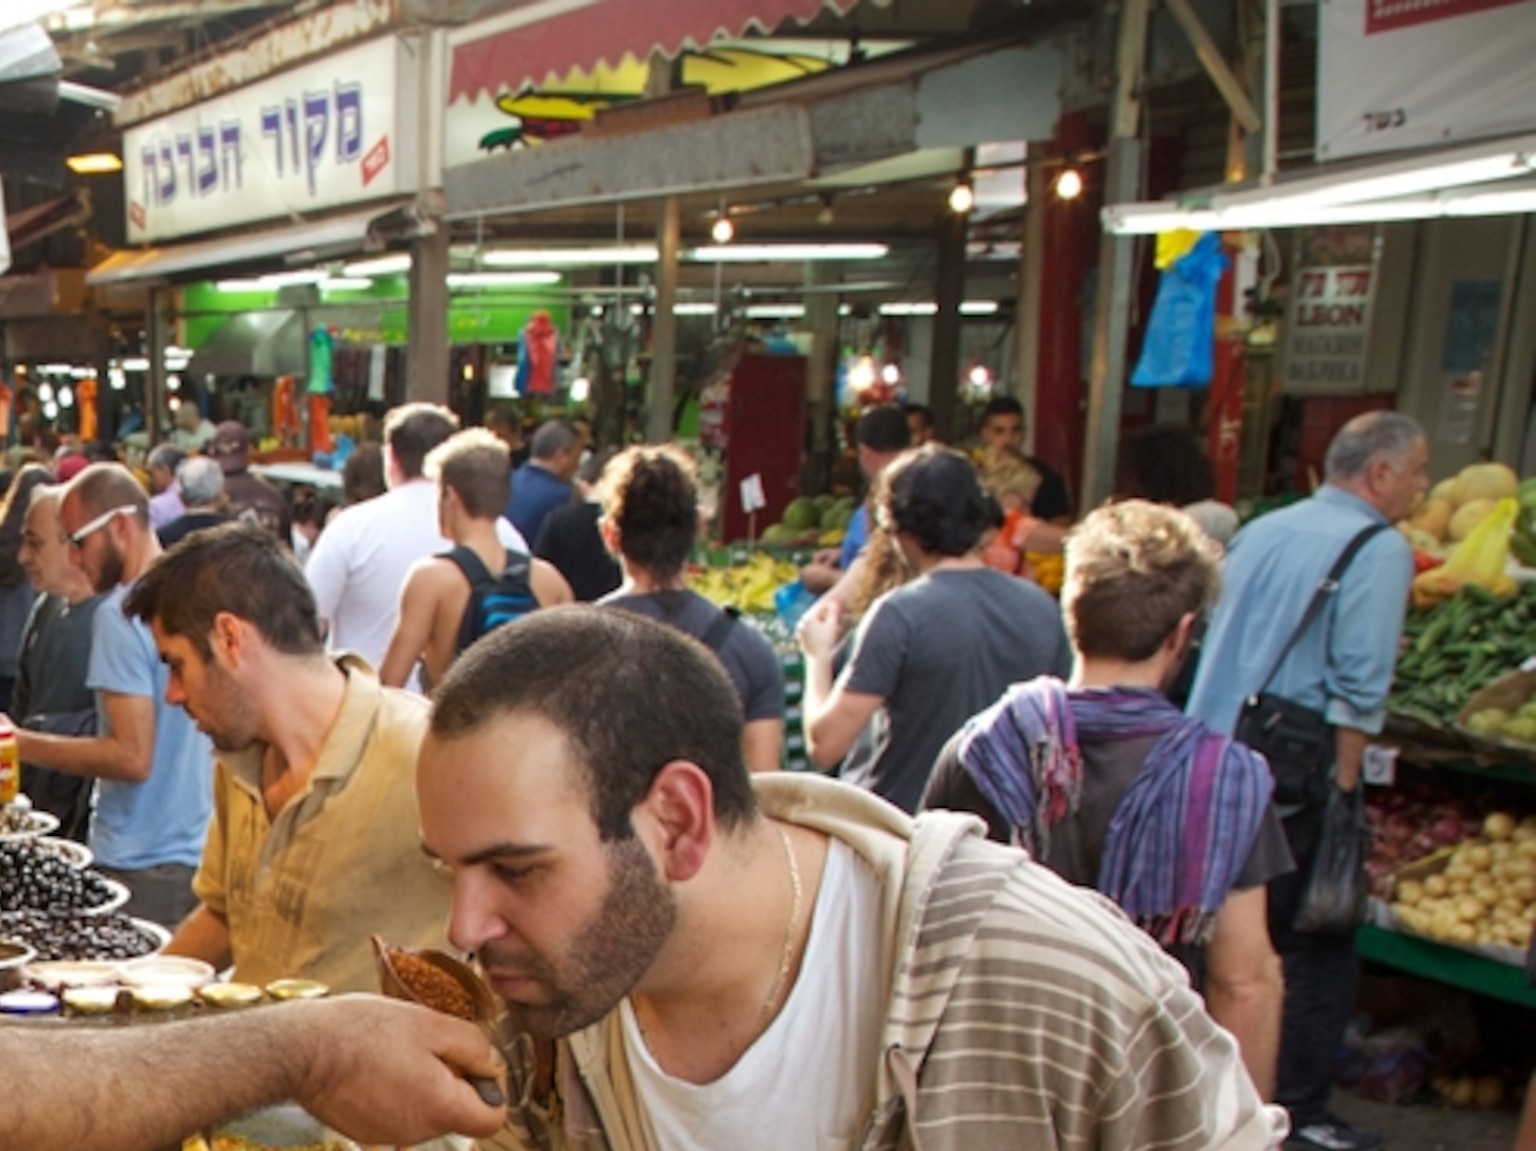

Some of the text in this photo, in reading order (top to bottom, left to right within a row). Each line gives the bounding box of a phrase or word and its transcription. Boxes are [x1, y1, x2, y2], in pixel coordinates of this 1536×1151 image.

[1362, 108, 1406, 132] כשר
[260, 79, 363, 195] מקור
[1296, 303, 1363, 327] LEON
